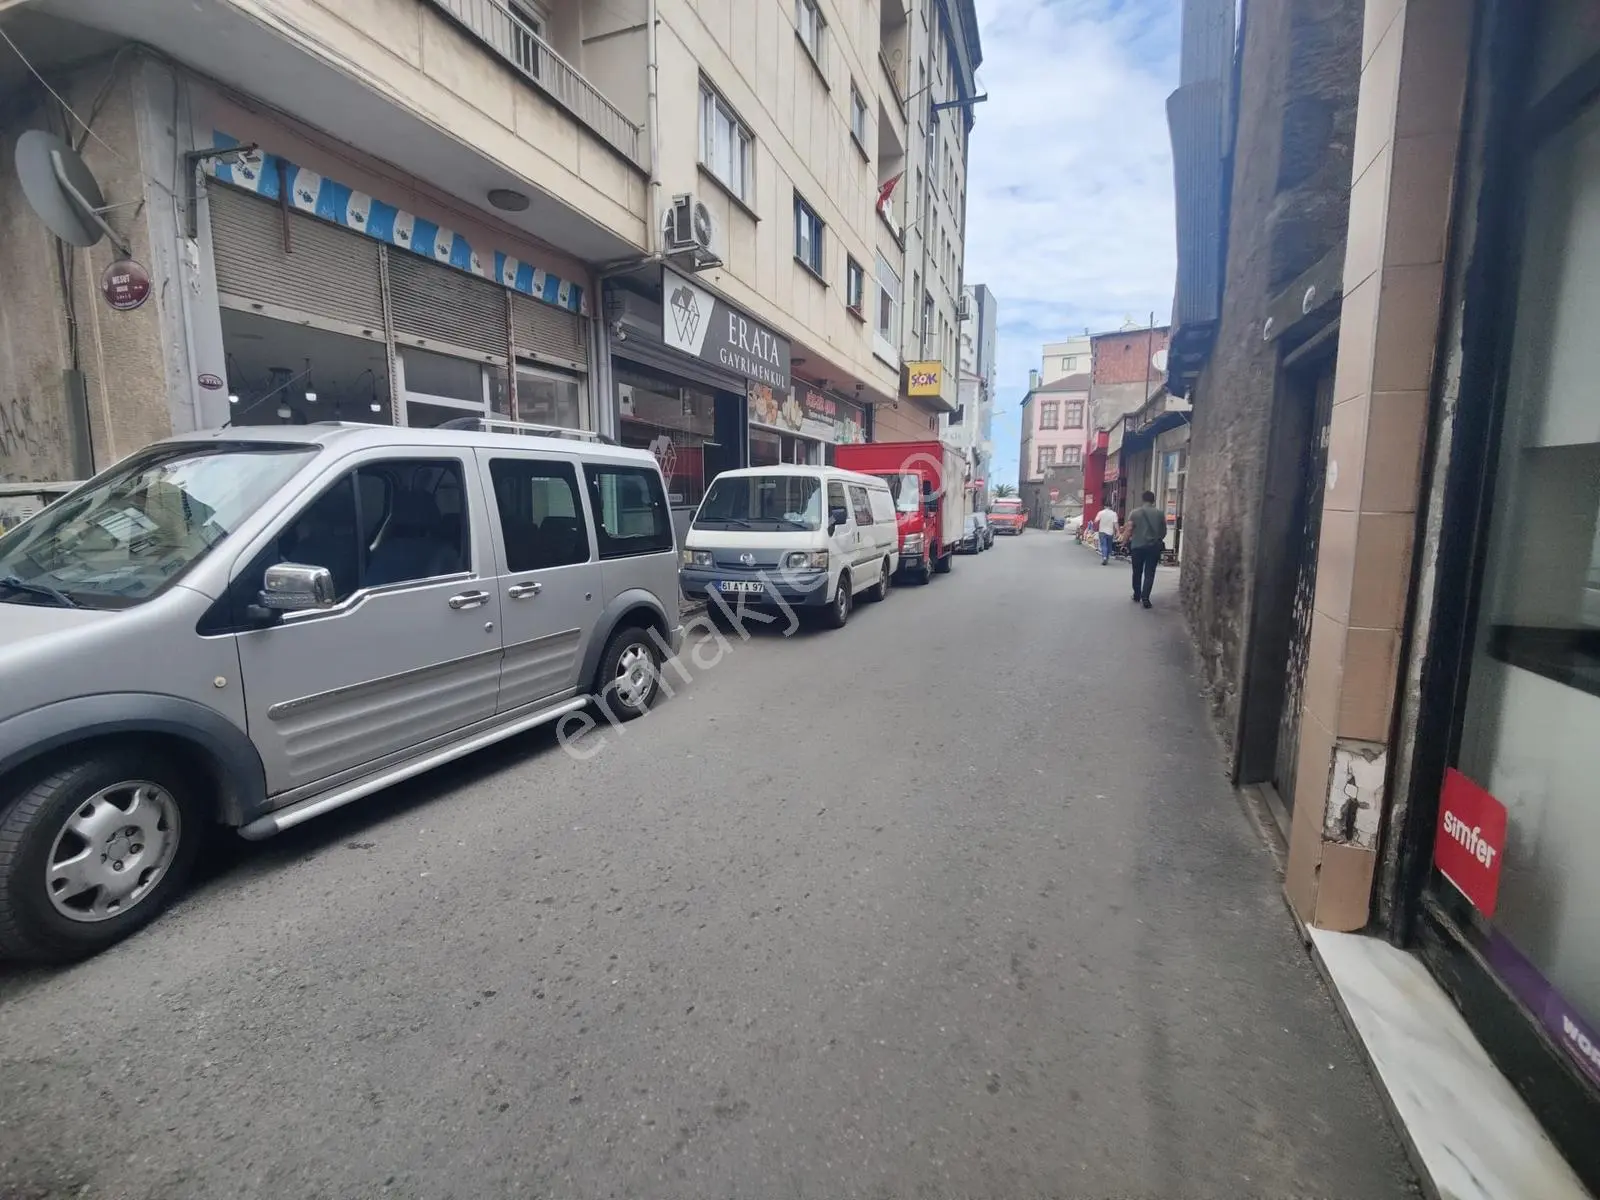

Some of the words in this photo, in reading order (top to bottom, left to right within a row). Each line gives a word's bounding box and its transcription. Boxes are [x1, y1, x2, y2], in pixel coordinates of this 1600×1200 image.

[727, 311, 780, 367] ERATA
[733, 582, 749, 590] ATA
[752, 583, 764, 591] 97
[1443, 810, 1497, 869] simfer
